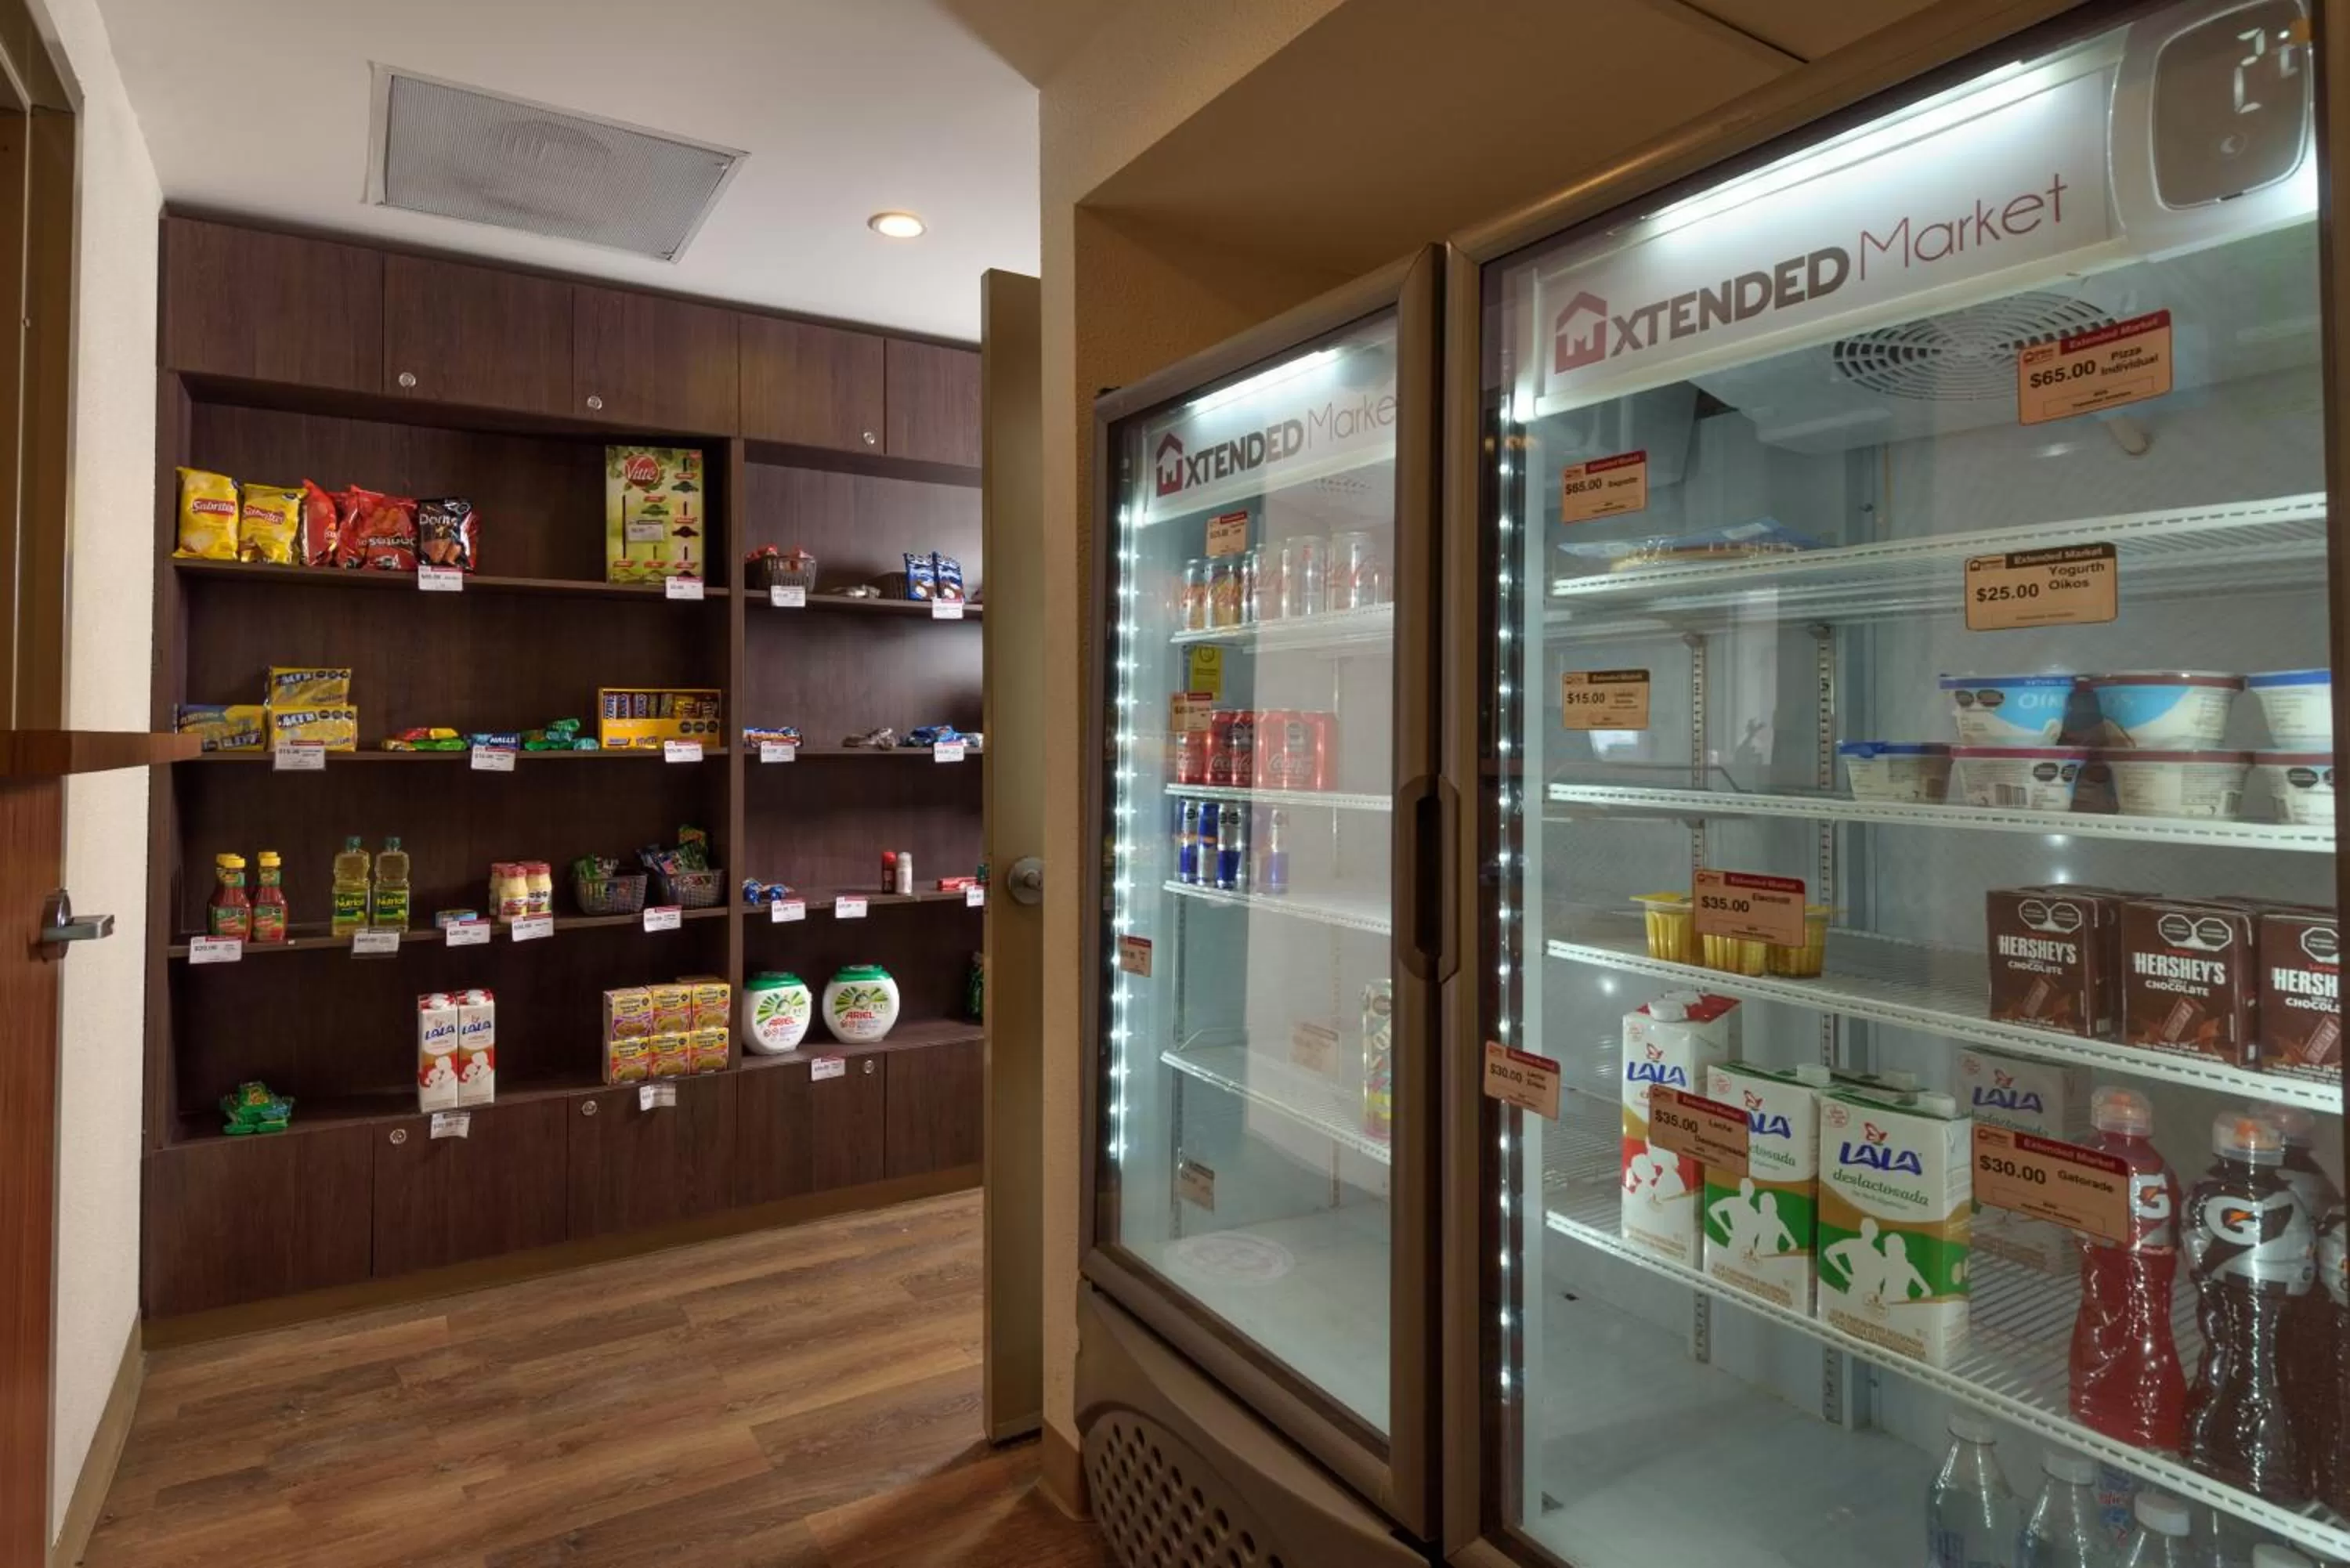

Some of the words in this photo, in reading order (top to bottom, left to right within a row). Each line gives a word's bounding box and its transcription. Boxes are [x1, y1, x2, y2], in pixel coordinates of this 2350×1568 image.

[1860, 173, 2067, 280] Market
[2030, 359, 2096, 388] $65.00
[1307, 395, 1397, 450] Marke
[2049, 562, 2105, 577] Yogurth
[1976, 583, 2040, 602] $25.00
[2048, 578, 2091, 591] Oikos
[1567, 692, 1605, 704] $15.00
[1701, 895, 1749, 912] $35.00
[1998, 934, 2077, 965] HERSHEY'S
[2007, 960, 2063, 975] CHOCOLATE
[2134, 952, 2225, 985] HERSHEY'S
[2145, 979, 2210, 998] CHOCOLATE
[2272, 967, 2339, 999] HERSH
[1628, 1061, 1687, 1086] LALA
[1972, 1086, 2044, 1114] LALA
[1654, 1109, 1698, 1133] $35.00
[1838, 1141, 1923, 1176] LALA
[1832, 1169, 1929, 1207] deslactosada
[1979, 1154, 2047, 1186] $30.00
[2056, 1169, 2115, 1194] Gatorade
[2204, 1195, 2265, 1246] G
